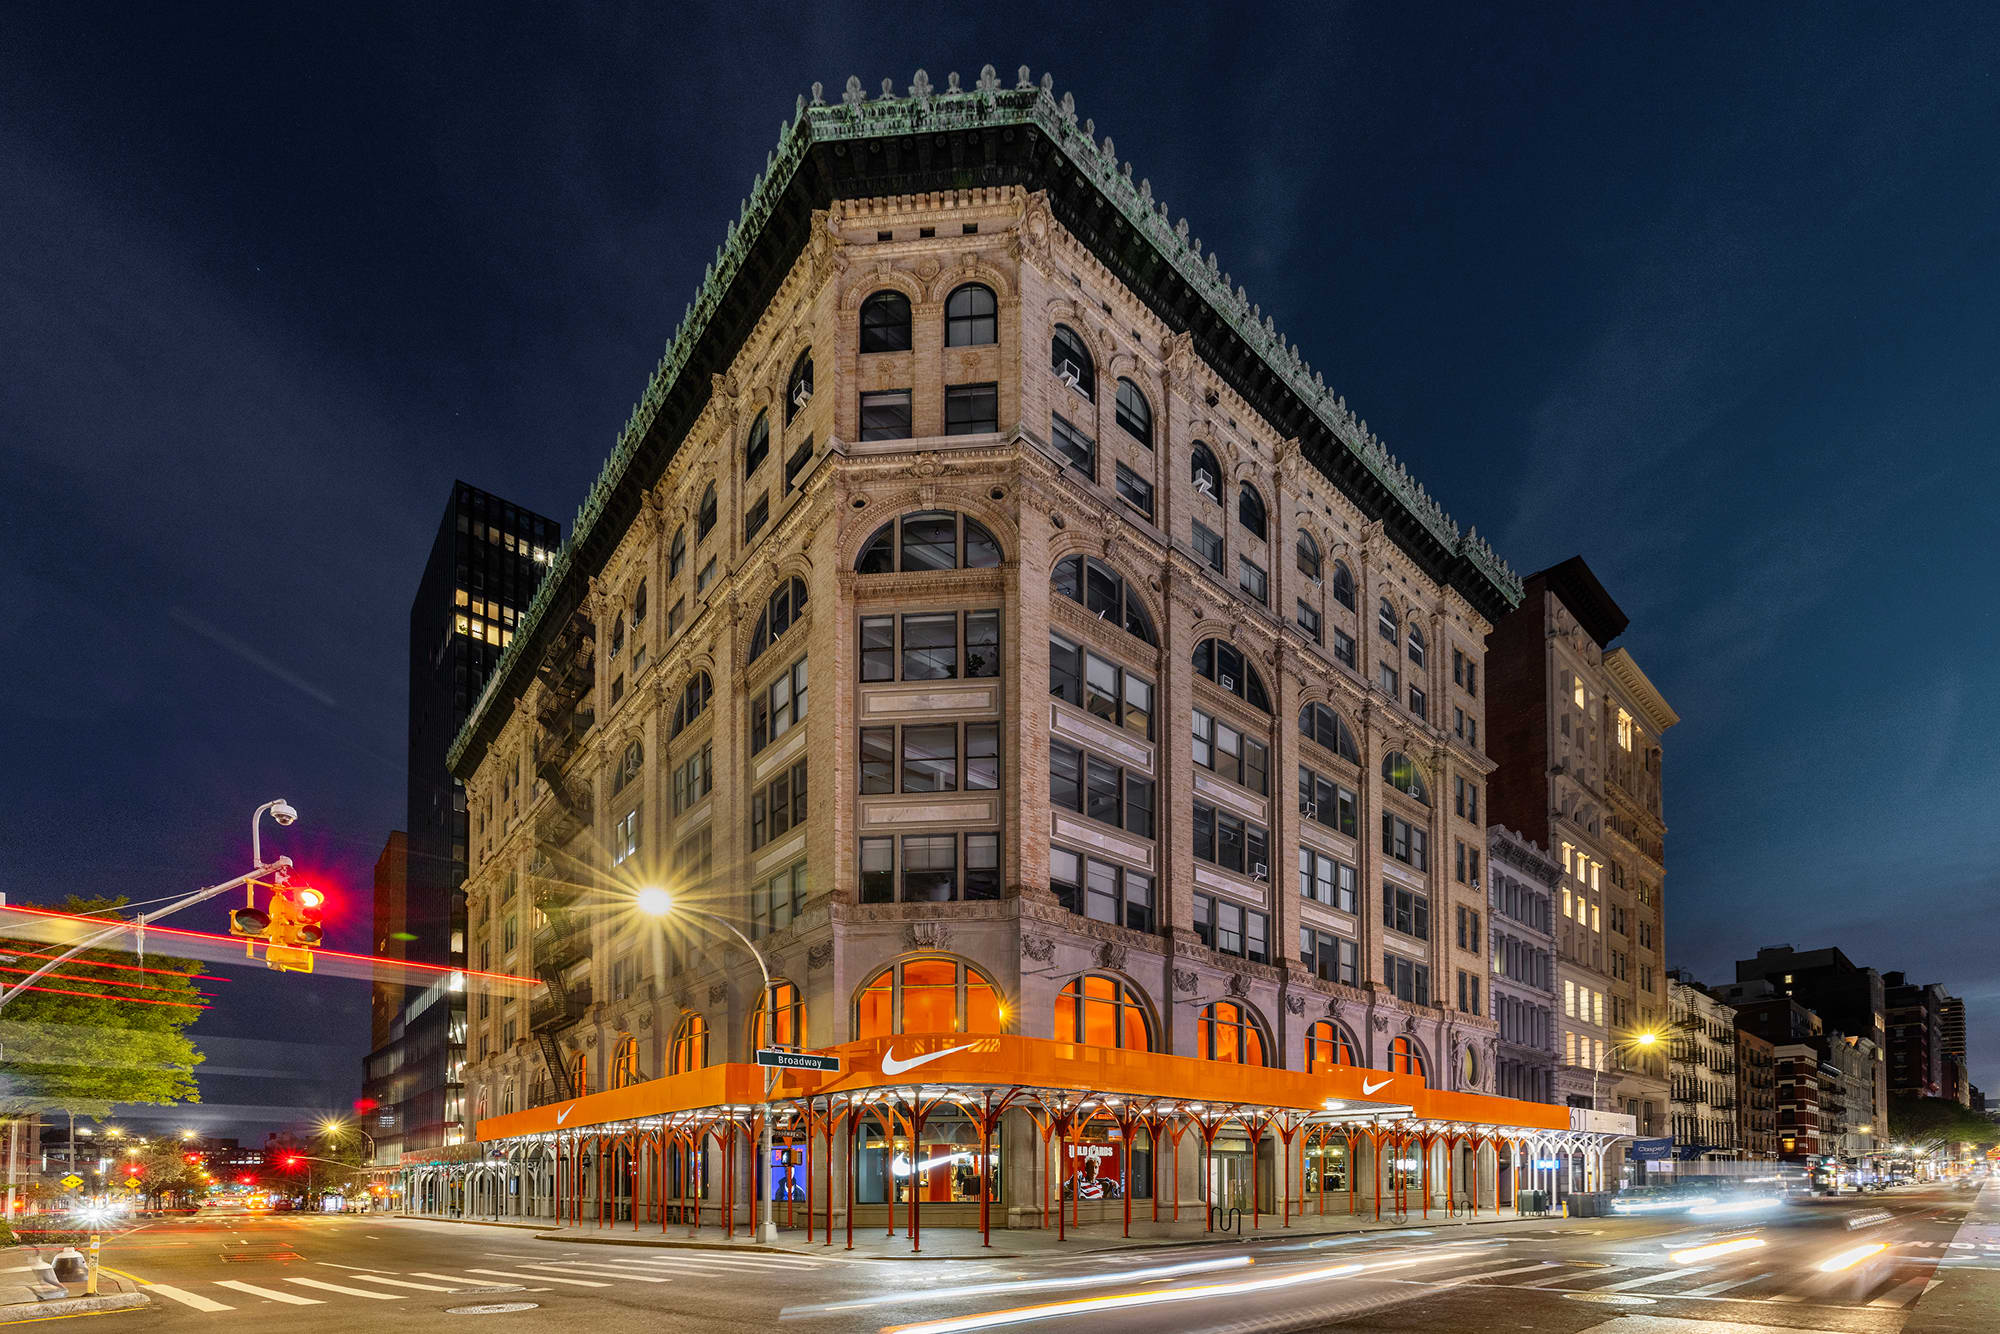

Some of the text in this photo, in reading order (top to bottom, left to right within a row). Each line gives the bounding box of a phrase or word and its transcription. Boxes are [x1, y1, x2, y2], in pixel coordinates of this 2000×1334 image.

[778, 1055, 822, 1069] Broadway
[1569, 1107, 1587, 1130] 611
[1638, 1144, 1666, 1153] Casper
